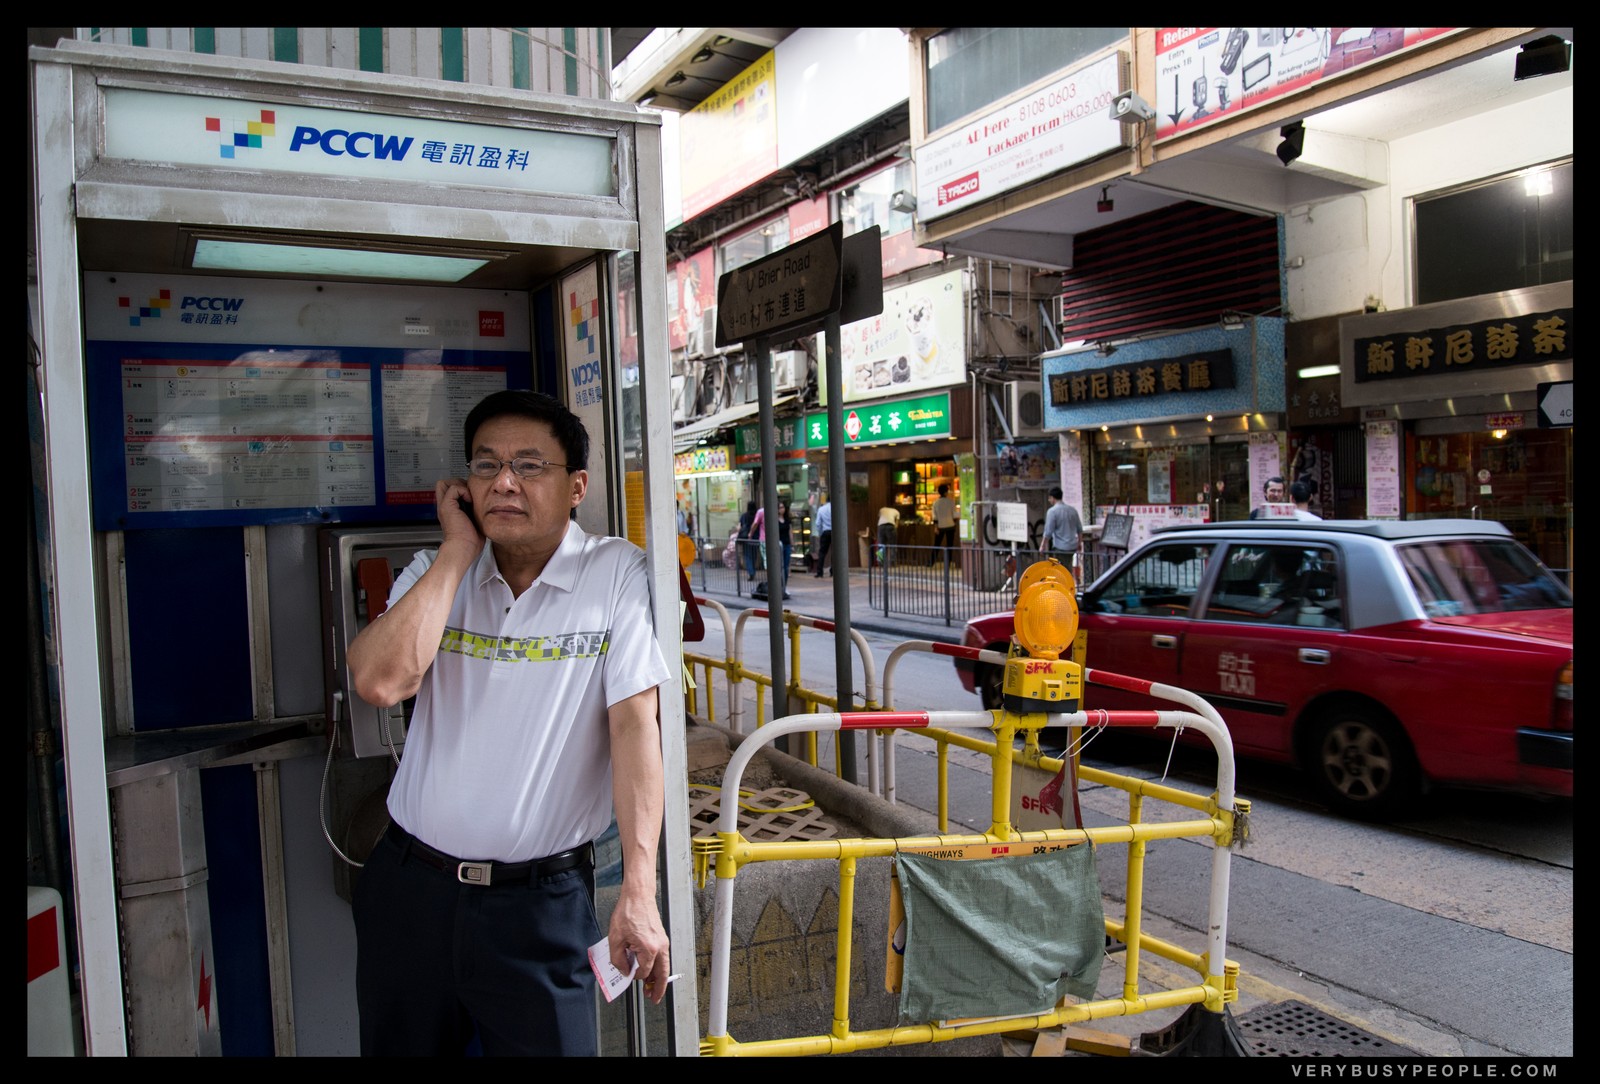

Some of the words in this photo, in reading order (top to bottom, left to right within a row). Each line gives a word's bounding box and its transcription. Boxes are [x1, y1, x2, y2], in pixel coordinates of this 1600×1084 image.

[1168, 49, 1185, 60] Entry
[1162, 61, 1181, 75] Press
[1277, 62, 1303, 77] Backdrop
[1304, 56, 1319, 69] Cloth
[1276, 72, 1302, 86] Backdrop
[1255, 86, 1270, 98] Light
[1019, 97, 1045, 122] 8108
[1048, 83, 1077, 108] 0603
[289, 126, 415, 162] PCCW
[420, 140, 531, 171] 電訊盈科
[946, 178, 978, 199] TACKO
[784, 250, 811, 278] Road
[180, 296, 245, 311] PCCW
[180, 312, 238, 325] 電訊盈科
[1366, 315, 1566, 374] 新軒尼詩茶
[1052, 360, 1212, 403] 新軒尼詩茶餐廳
[1025, 662, 1054, 675] SFK
[1217, 671, 1256, 696] TAXI
[1022, 795, 1050, 815] SFK
